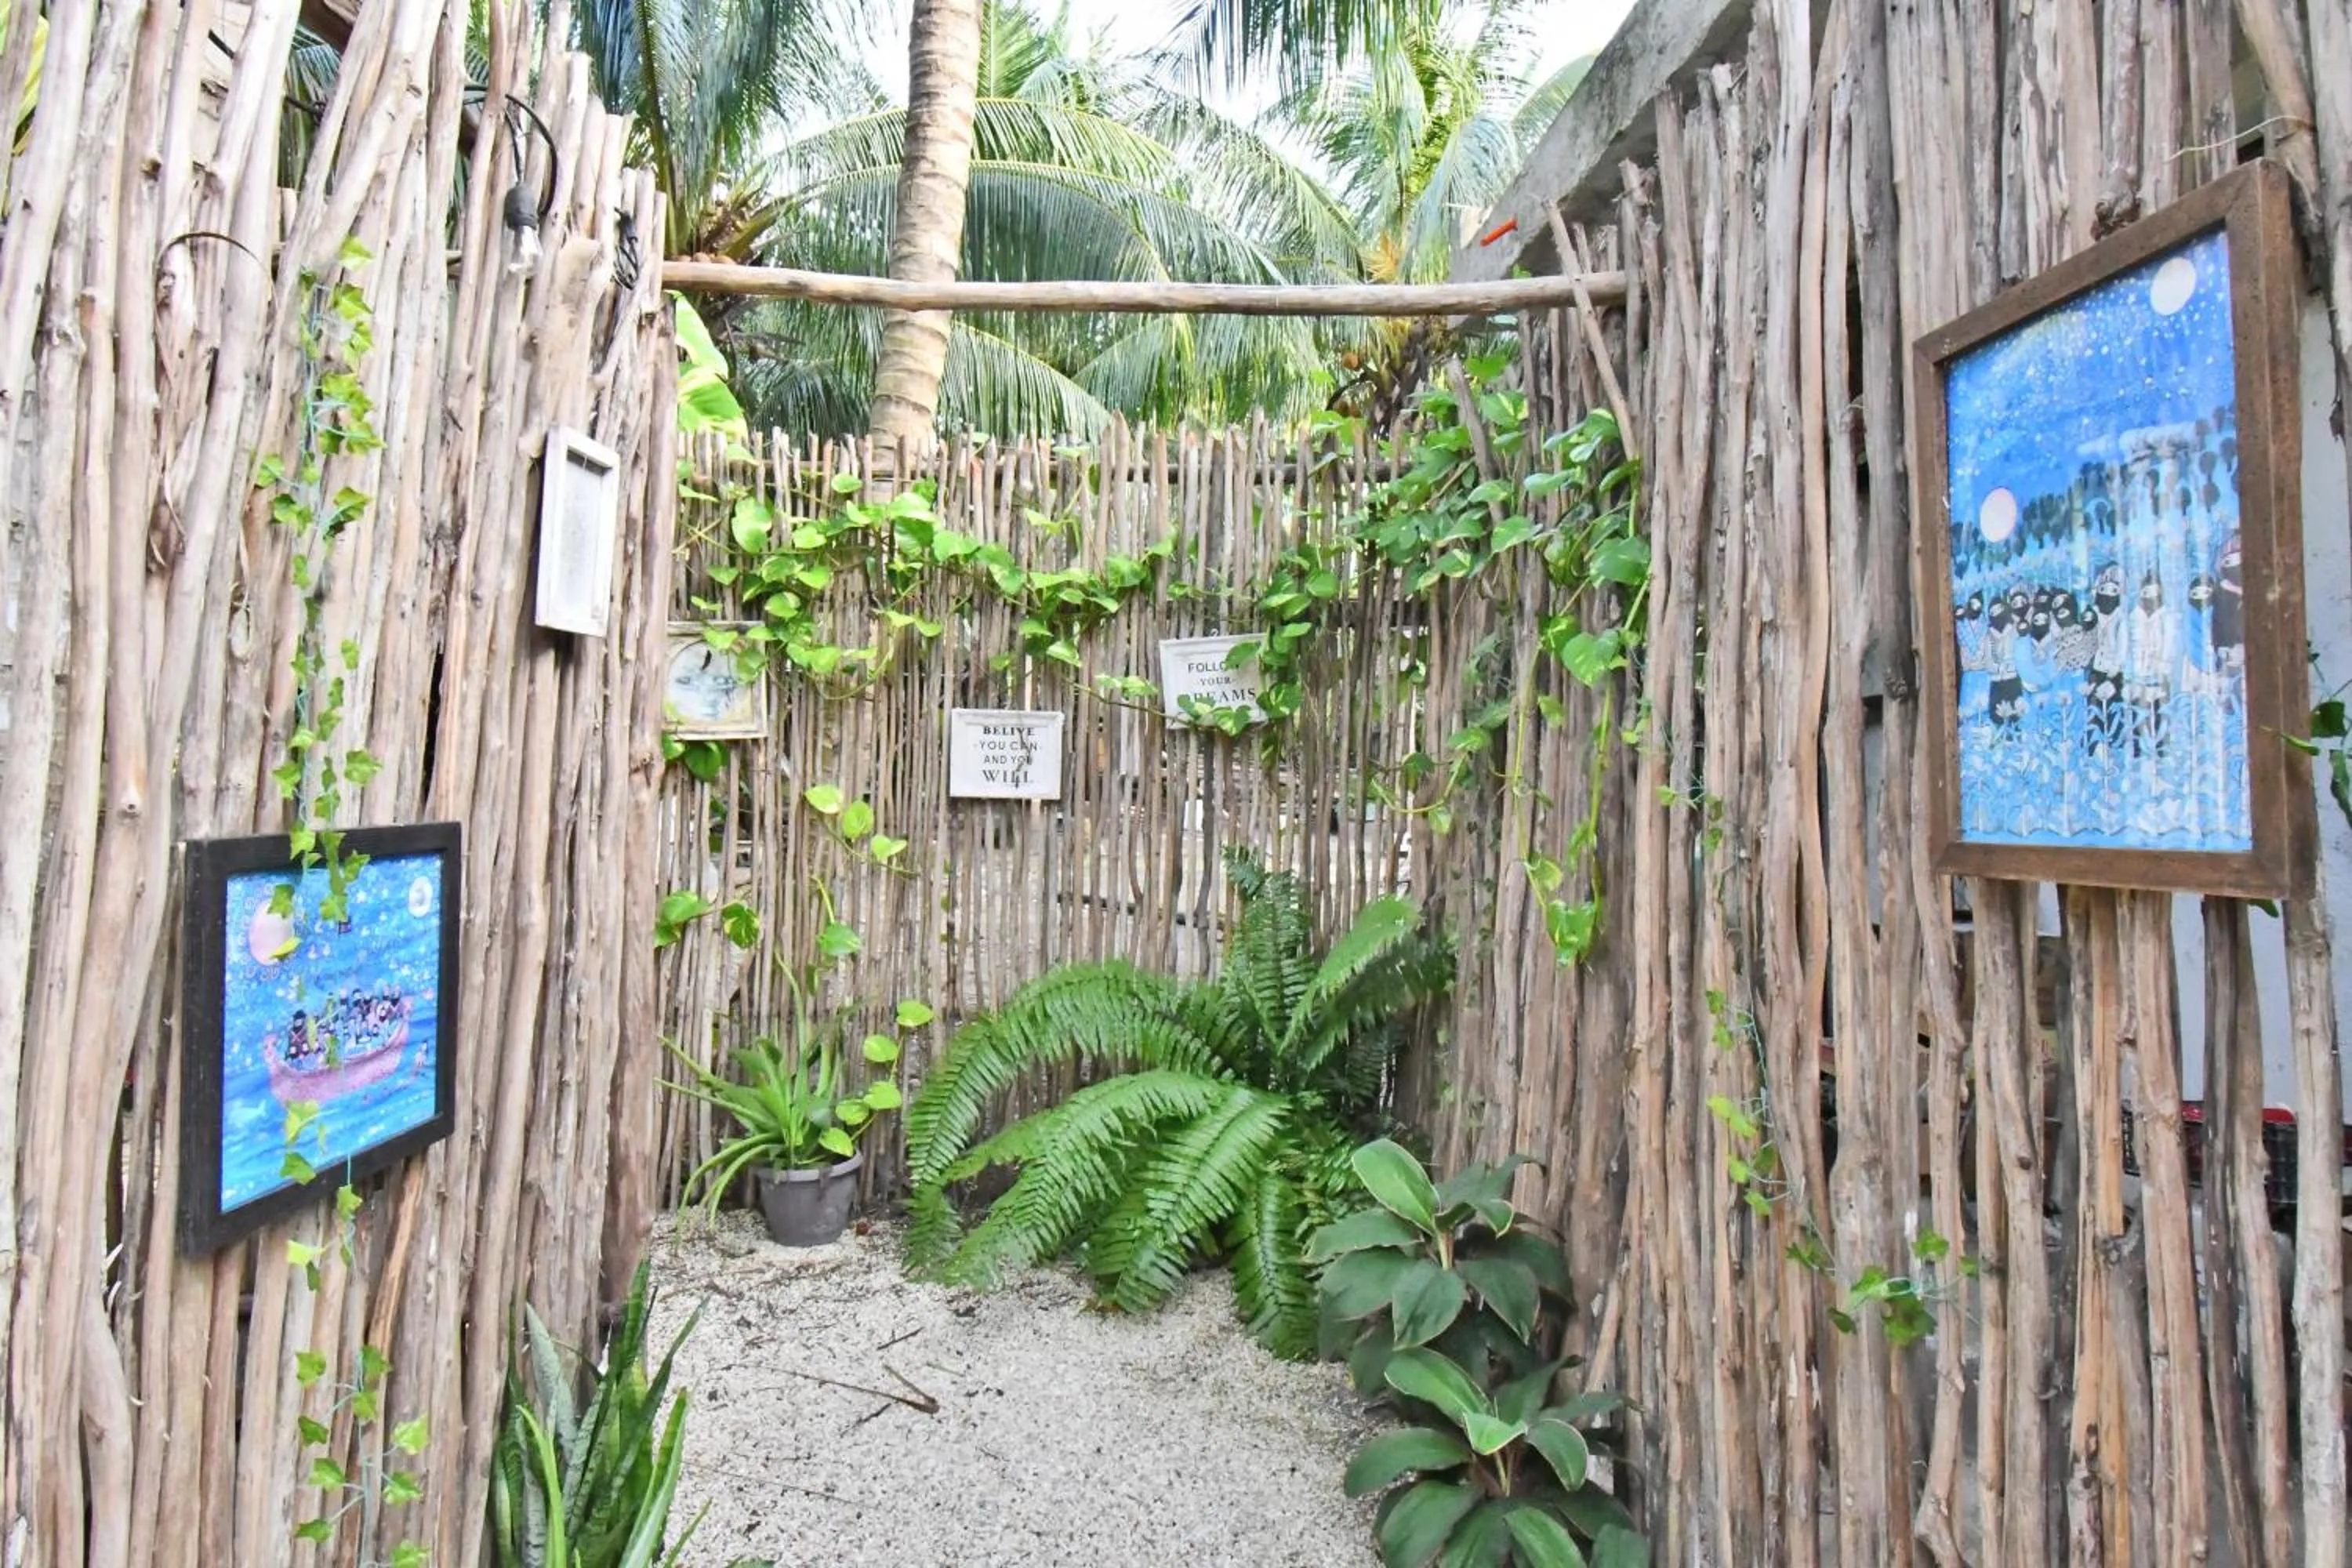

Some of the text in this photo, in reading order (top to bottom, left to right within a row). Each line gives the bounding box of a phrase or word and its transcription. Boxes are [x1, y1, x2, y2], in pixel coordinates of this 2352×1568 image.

[1188, 661, 1240, 673] FOLLO
[1200, 677, 1231, 686] YOUR
[1192, 688, 1256, 703] REAMS
[983, 725, 1036, 736] BELIVE
[979, 741, 1038, 751] YOU CAN
[983, 755, 1033, 765] AND YOU
